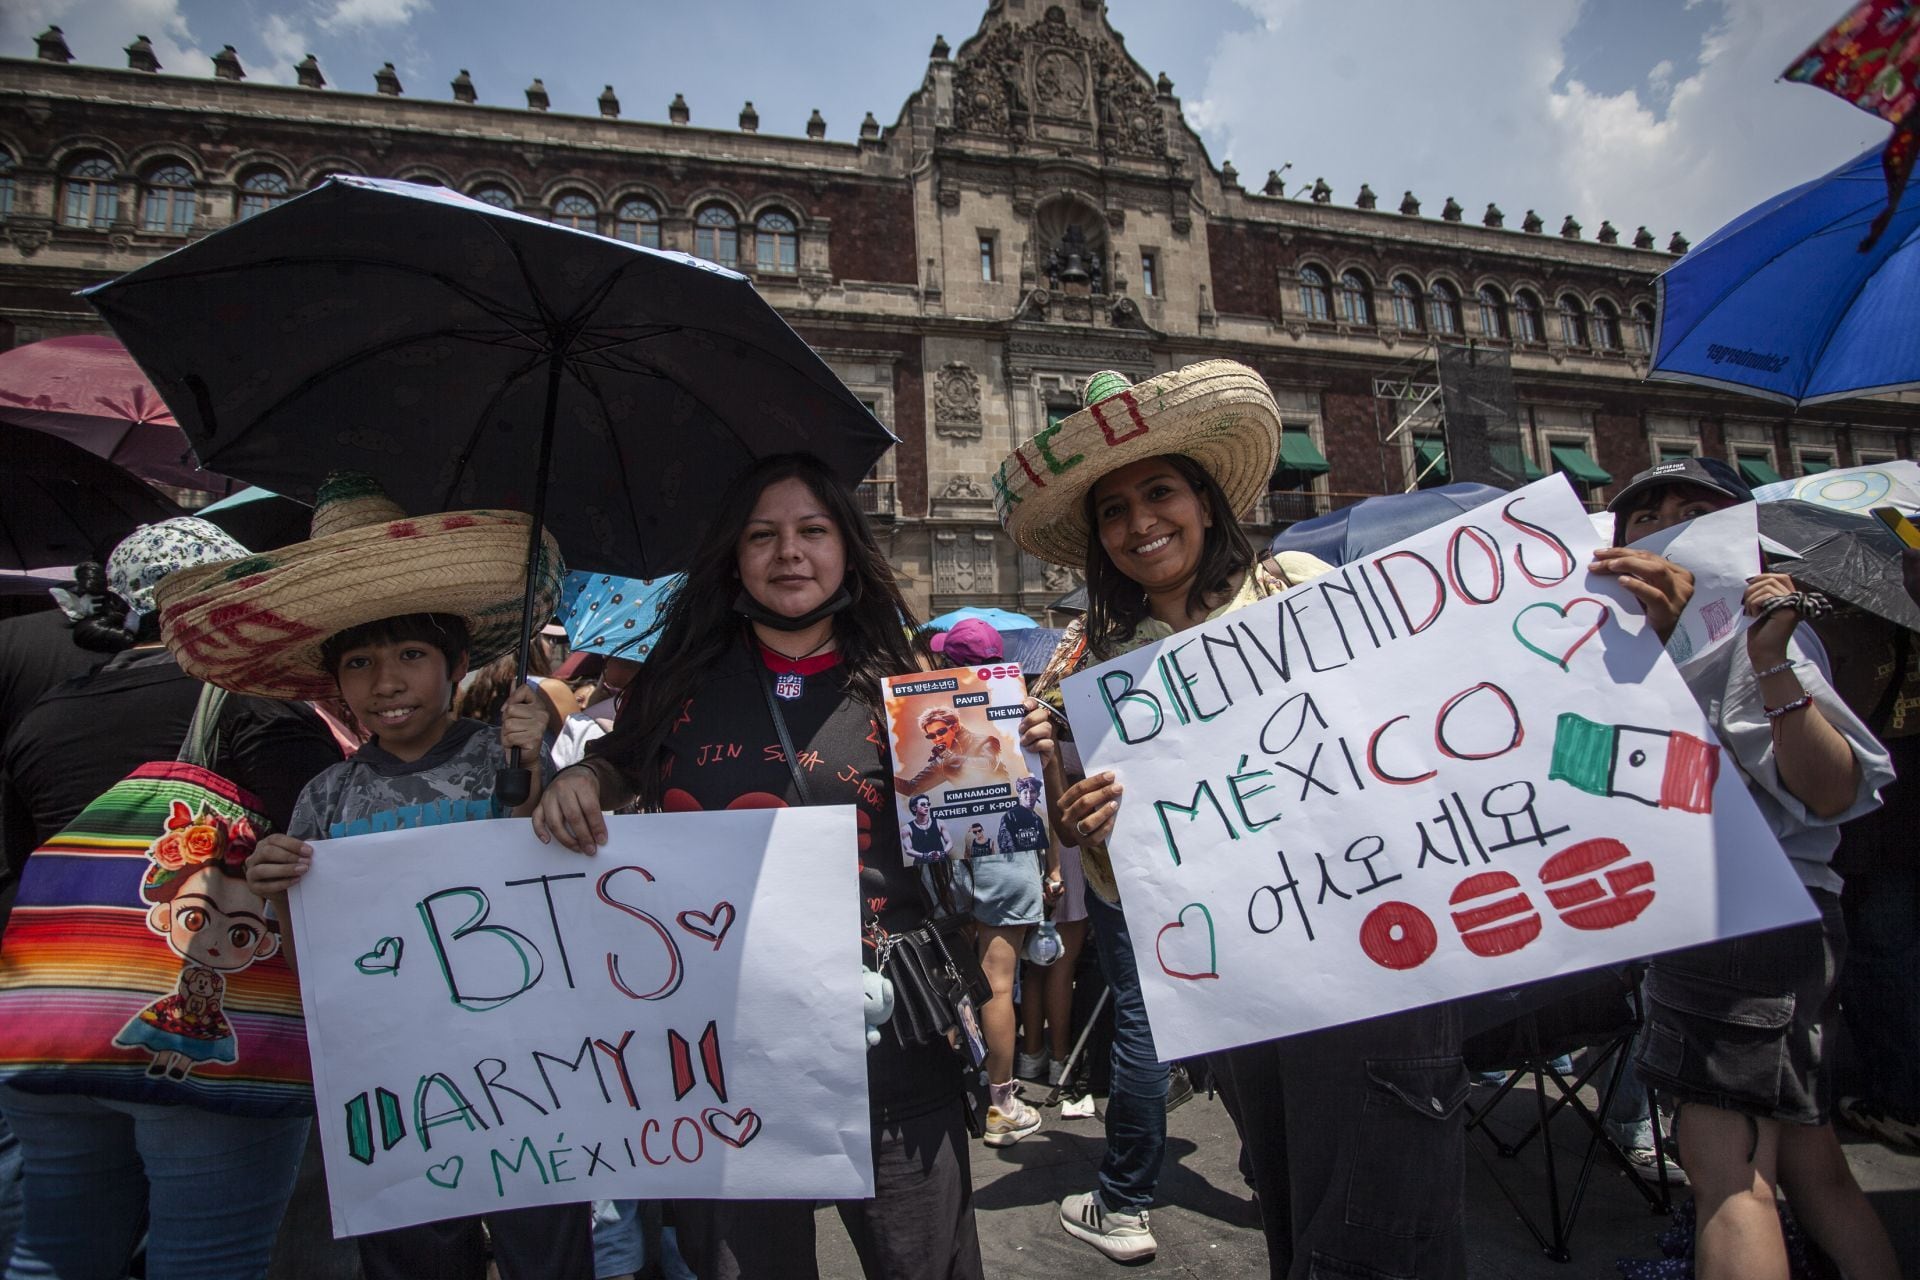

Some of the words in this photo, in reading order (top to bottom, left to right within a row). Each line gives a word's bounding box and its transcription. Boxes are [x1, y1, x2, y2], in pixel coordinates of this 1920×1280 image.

[1097, 497, 1577, 746] BIENVENIDOS
[777, 683, 800, 697] BTS
[895, 685, 913, 694] BTS
[914, 679, 956, 692] 방탄소년단
[956, 695, 985, 704] PAVED
[696, 743, 742, 766] JIN
[1153, 681, 1525, 867] MÉXICO
[946, 792, 963, 800] KIM
[964, 786, 1007, 797] NAMJOON
[932, 807, 968, 818] FATHER
[972, 804, 985, 812] OF
[989, 800, 1017, 811] K-POP
[415, 865, 685, 1013] BTS
[412, 1030, 642, 1152] ARMY
[490, 1116, 704, 1197] MÉXICO
